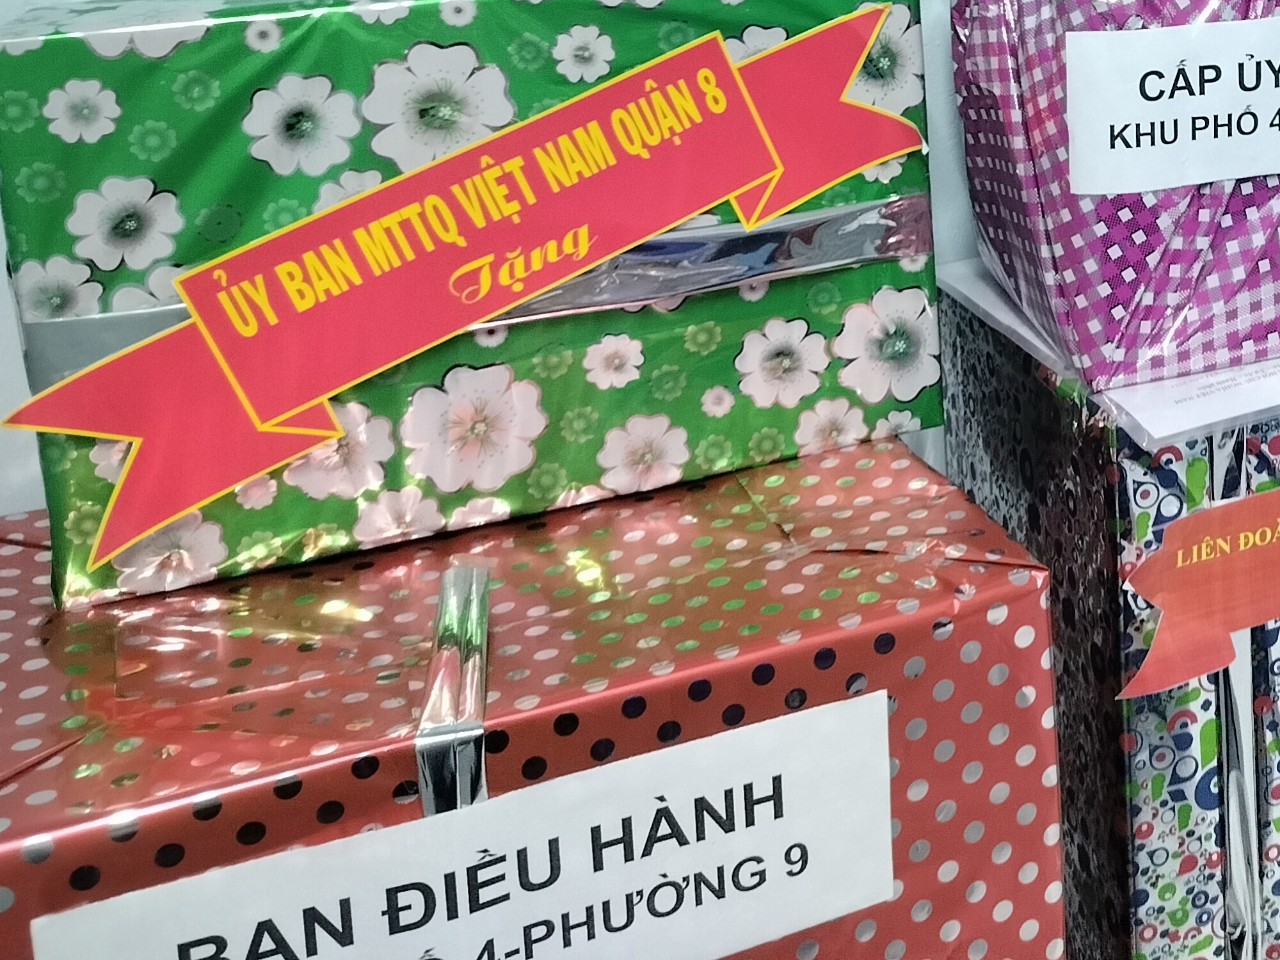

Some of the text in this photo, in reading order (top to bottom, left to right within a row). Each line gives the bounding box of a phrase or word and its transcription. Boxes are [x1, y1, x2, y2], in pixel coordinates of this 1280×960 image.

[1139, 57, 1222, 101] CẤP
[1109, 118, 1180, 150] KHU
[1191, 105, 1259, 141] PHỐ
[213, 67, 727, 337] ỦY BAN MTTQ VIỆT NAM QUẬN 8
[449, 224, 598, 304] Tặng
[1176, 536, 1230, 568] LIÊN
[381, 837, 561, 936] ĐIỀU
[590, 774, 784, 872] HÀNH
[784, 842, 809, 877] 9
